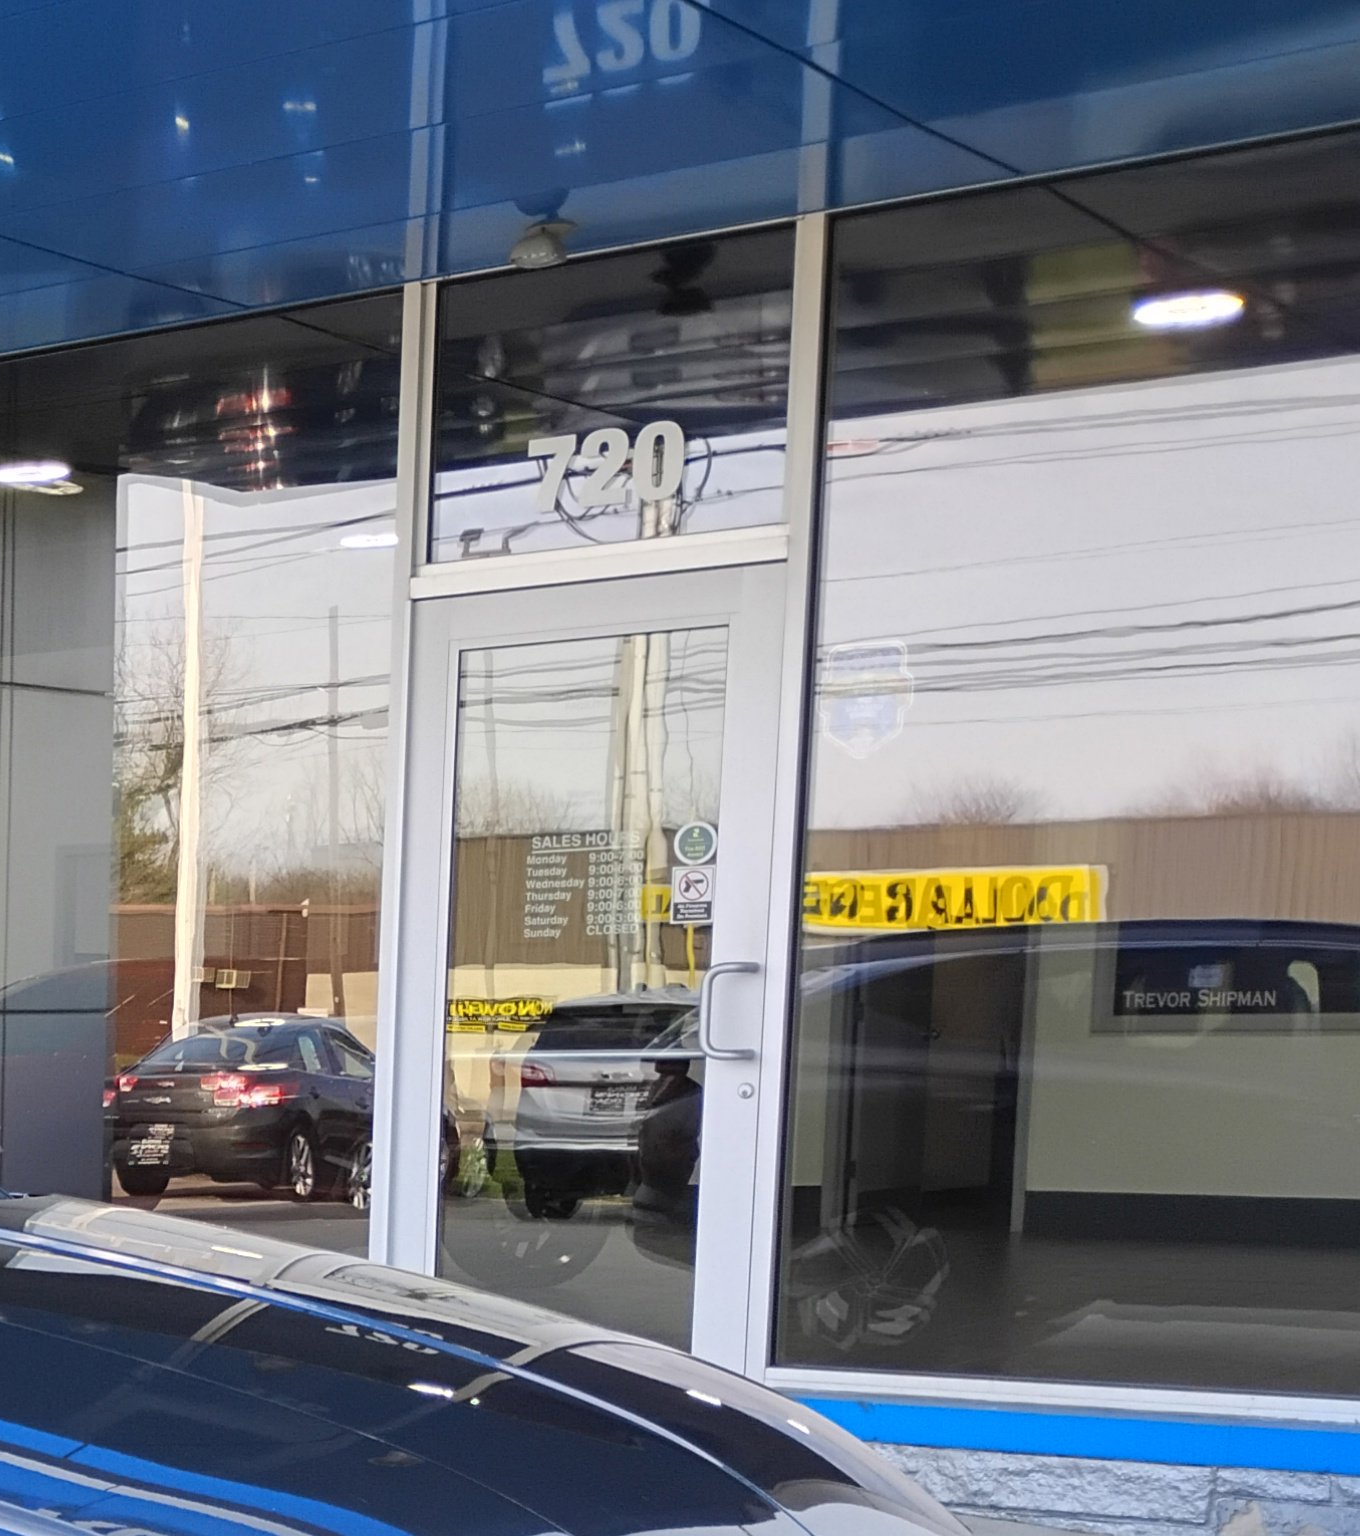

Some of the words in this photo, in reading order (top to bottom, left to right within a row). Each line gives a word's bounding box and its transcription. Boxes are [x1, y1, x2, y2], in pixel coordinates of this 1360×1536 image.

[527, 420, 685, 512] 720
[532, 834, 582, 849] SALES
[527, 855, 568, 866] Monday
[588, 850, 644, 863] 9:00-700
[526, 866, 568, 878] Tuesday
[588, 863, 644, 876] 9:00-600
[525, 878, 586, 890] Wednesday
[525, 891, 573, 902] Thursday
[524, 903, 557, 914] Friday
[524, 915, 569, 927] Saturday
[523, 928, 562, 940] Sunday
[586, 924, 640, 936] CLOSED
[1122, 990, 1192, 1008] TREVOR
[1197, 989, 1277, 1007] SHIPMAN
